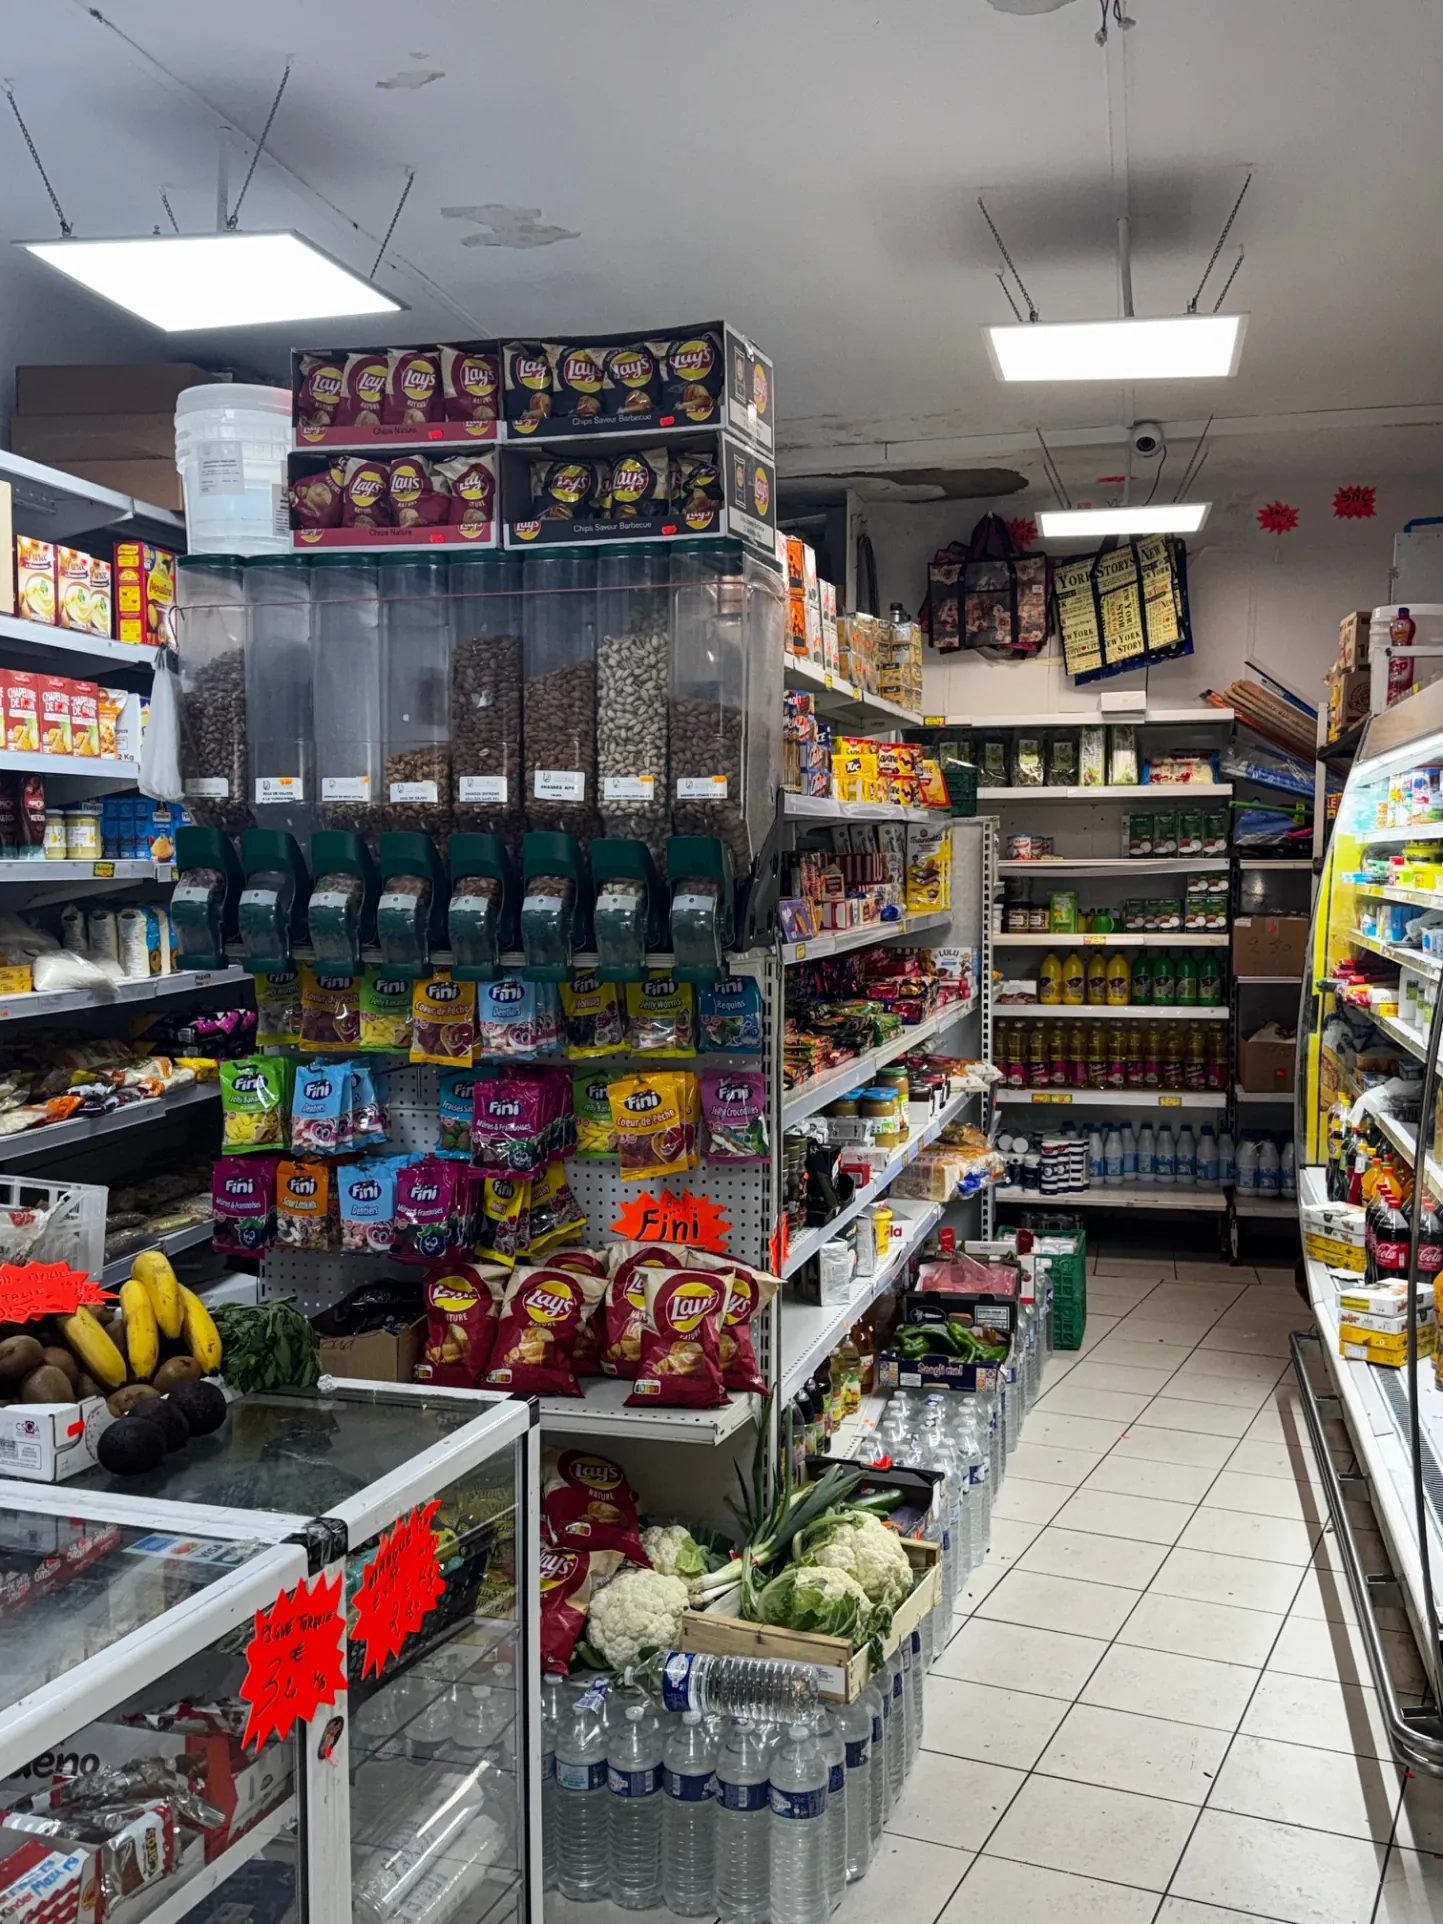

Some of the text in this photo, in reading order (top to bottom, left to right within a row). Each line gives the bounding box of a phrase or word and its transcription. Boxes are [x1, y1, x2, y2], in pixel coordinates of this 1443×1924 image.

[572, 416, 594, 427] Chips
[619, 412, 652, 423] Barbecue
[573, 524, 594, 534] Chips
[619, 520, 652, 531] Barbecue
[319, 975, 352, 990] Fini
[376, 979, 406, 994] Fini
[645, 978, 676, 995] Fini
[715, 978, 744, 995] Fini
[428, 984, 458, 999] Fini
[717, 999, 746, 1010] Requins
[306, 1080, 331, 1097] Fini
[457, 1083, 474, 1097] Fin
[589, 1083, 608, 1099] Fin
[718, 1085, 749, 1102] Fini
[489, 1100, 520, 1116] Fini
[627, 1091, 658, 1111] Fini
[225, 1179, 254, 1196] Fini
[290, 1179, 316, 1195] Fini
[351, 1182, 380, 1199] Fini
[411, 1185, 438, 1201] Fini
[351, 1204, 380, 1216] Dentiers
[636, 1208, 699, 1242] Fini
[446, 1313, 469, 1323] TURE
[588, 1489, 614, 1501] NATURE
[196, 1544, 224, 1558] VISA
